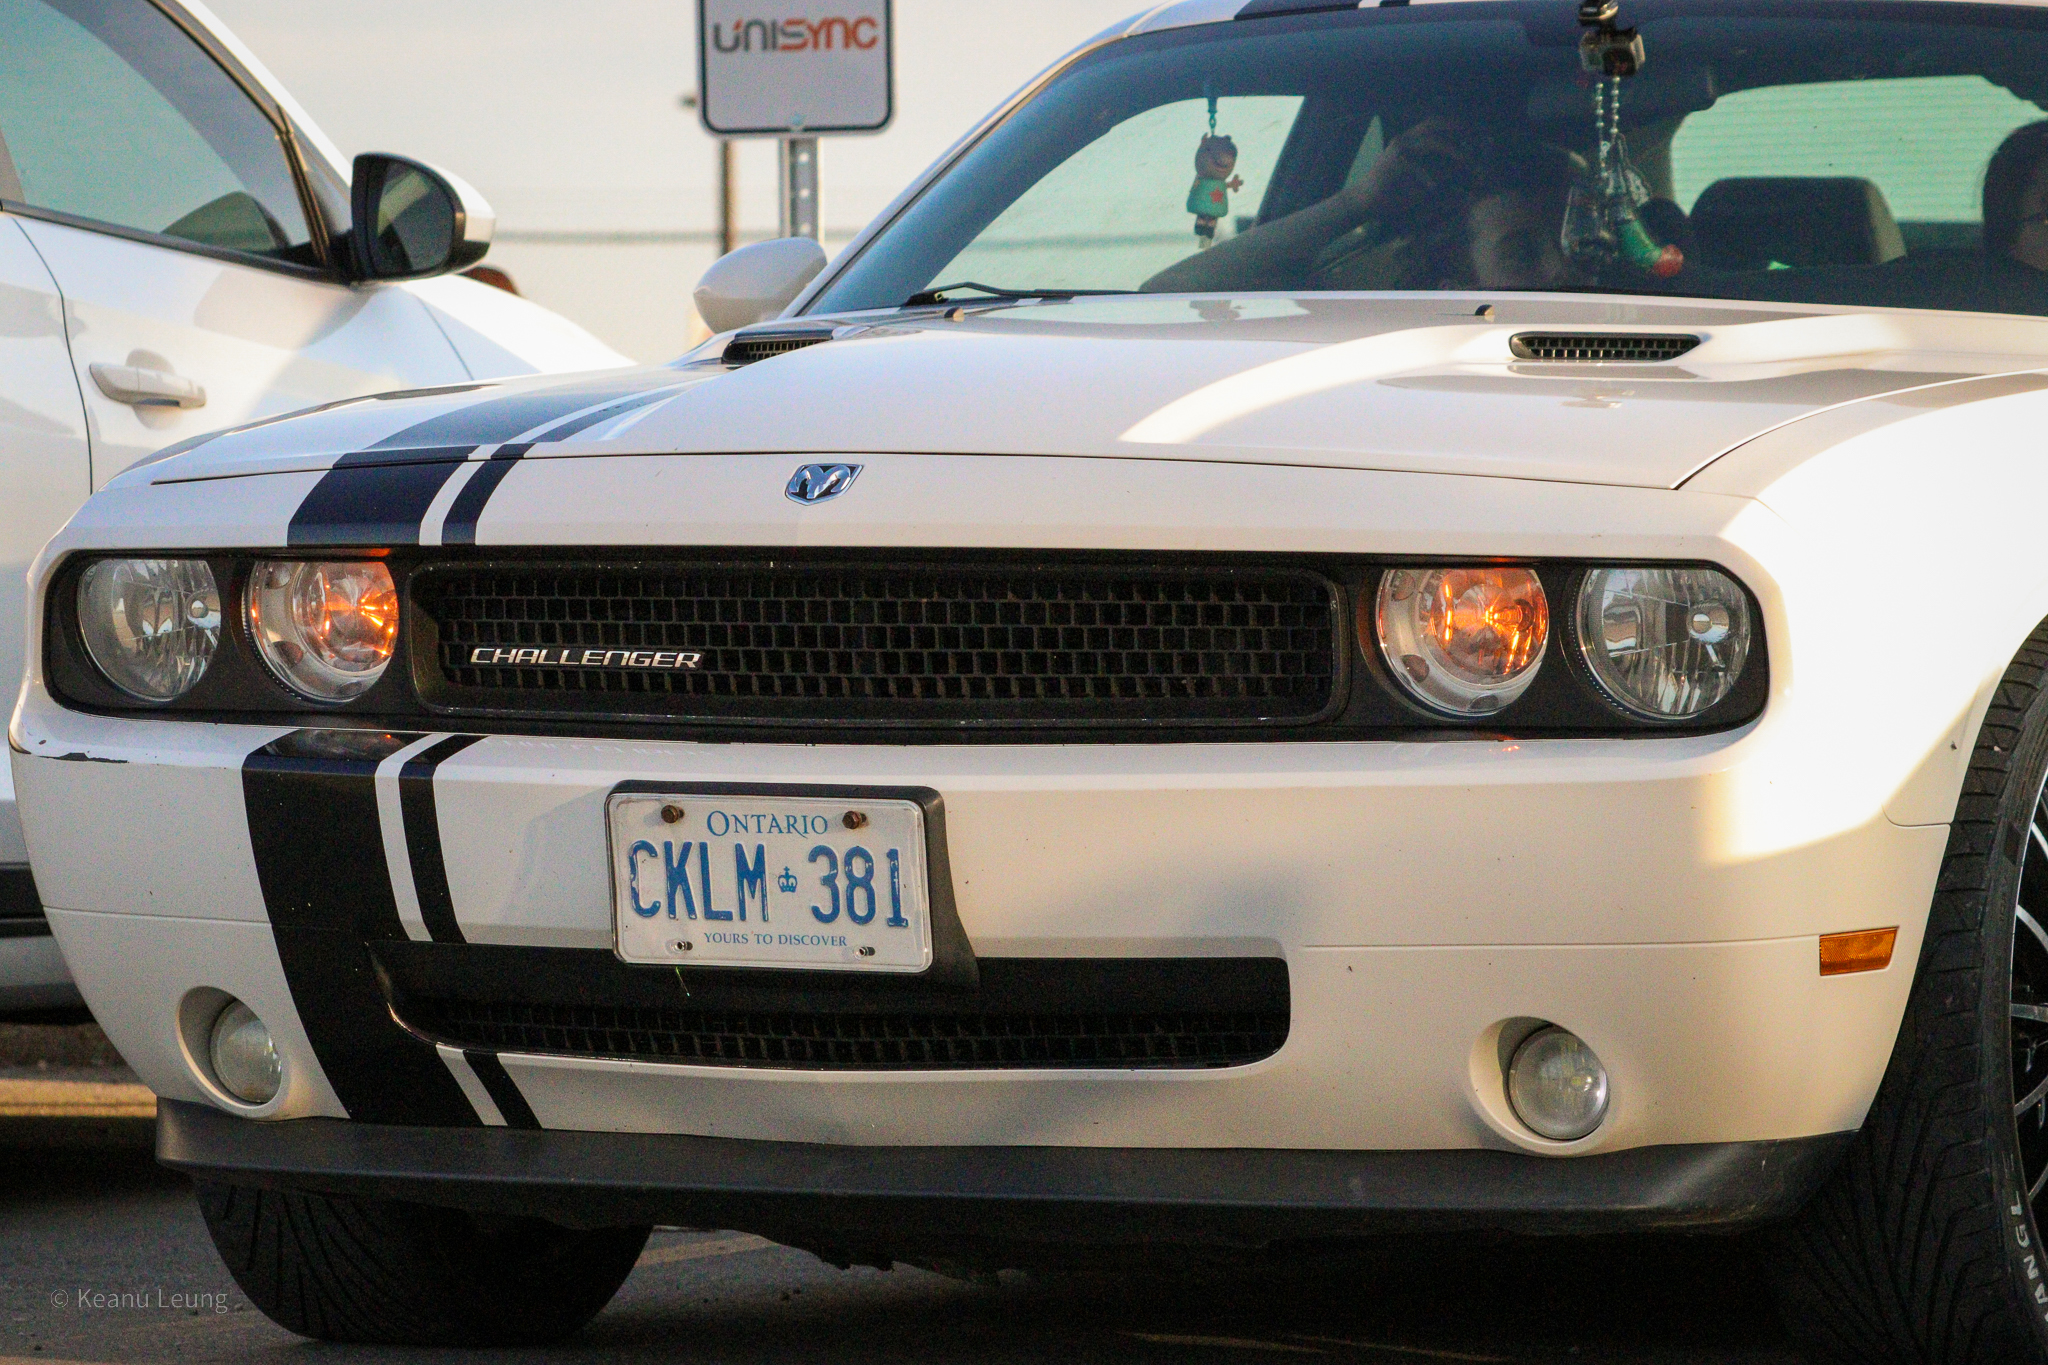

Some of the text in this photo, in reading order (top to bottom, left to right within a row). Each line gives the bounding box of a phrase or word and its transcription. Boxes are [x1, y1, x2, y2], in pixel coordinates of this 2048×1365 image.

[713, 16, 878, 53] UNISYNC
[470, 647, 702, 668] CHALLENGER
[706, 810, 829, 838] ONTARIO
[628, 839, 910, 928] CKLM 381
[704, 931, 848, 947] YOURS TO DISCOVER
